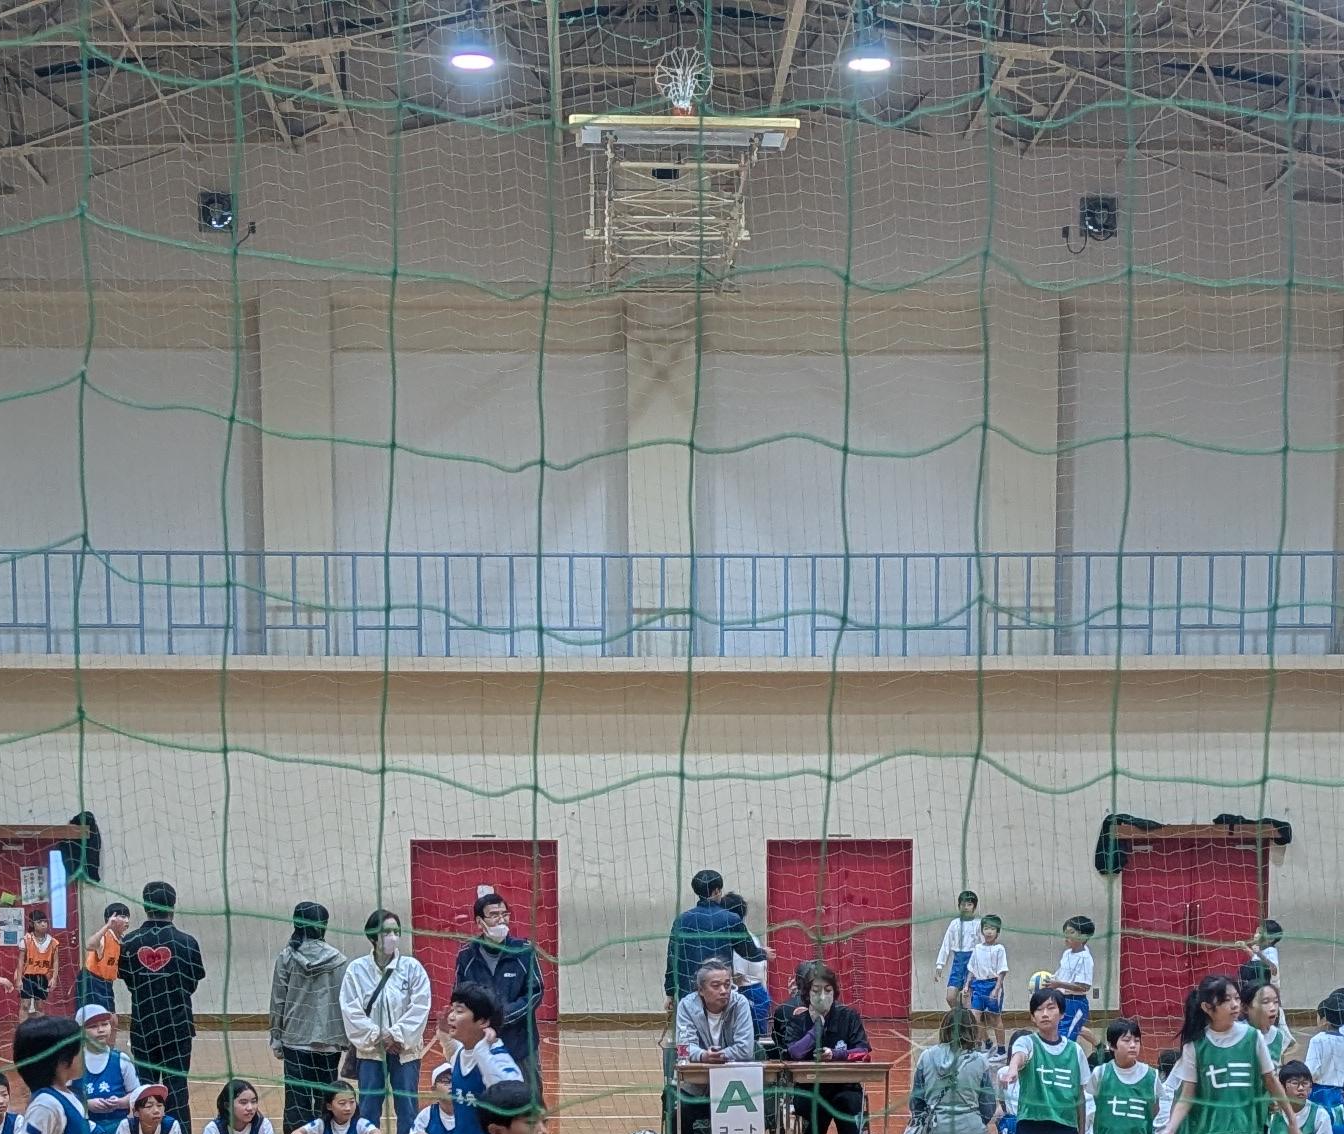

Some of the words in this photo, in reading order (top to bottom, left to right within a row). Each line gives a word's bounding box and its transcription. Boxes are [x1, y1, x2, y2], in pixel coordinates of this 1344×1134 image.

[1036, 1064, 1073, 1089] 七三
[1206, 1062, 1253, 1089] 七三
[716, 1080, 758, 1113] A
[1107, 1095, 1147, 1120] 七三
[719, 1124, 757, 1134] コート
